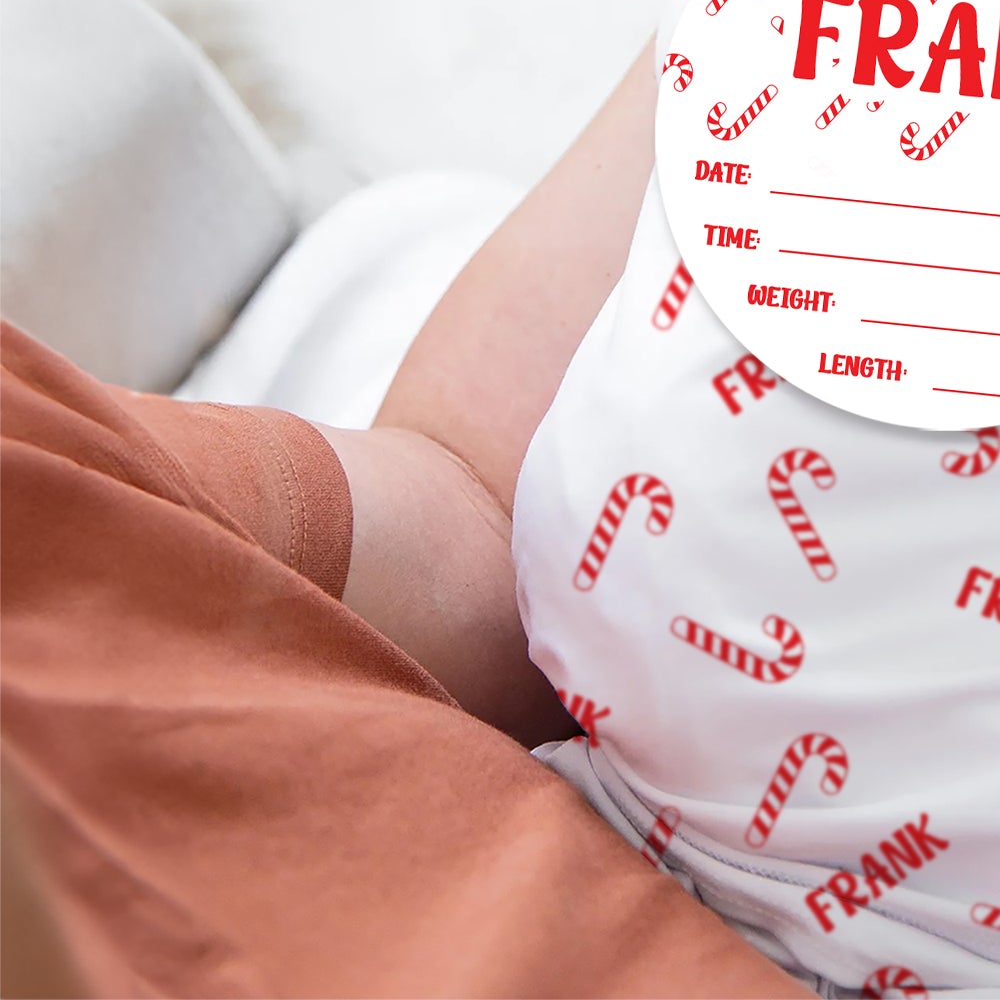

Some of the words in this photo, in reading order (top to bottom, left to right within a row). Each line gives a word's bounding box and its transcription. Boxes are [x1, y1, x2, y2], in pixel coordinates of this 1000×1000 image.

[695, 159, 752, 186] DATE:
[703, 223, 761, 251] TIME:
[747, 283, 836, 313] WEIGHT:
[817, 352, 908, 382] LENGTH:
[804, 812, 950, 934] FRANK
